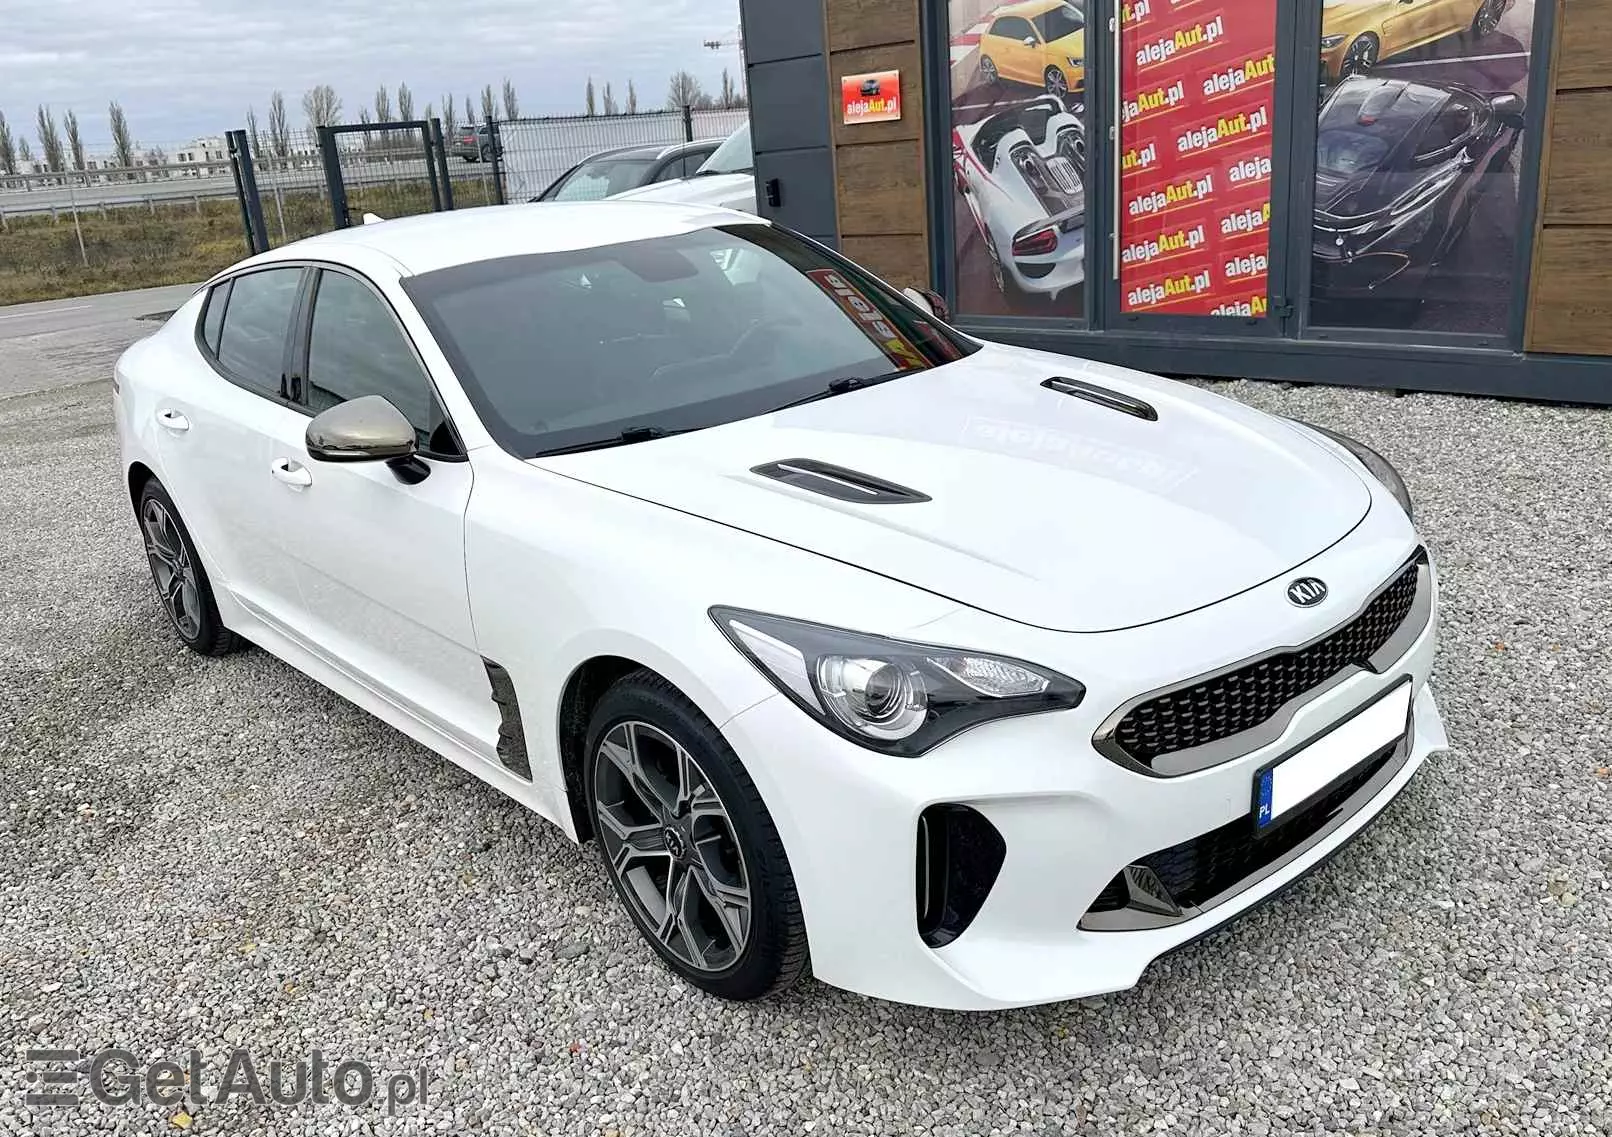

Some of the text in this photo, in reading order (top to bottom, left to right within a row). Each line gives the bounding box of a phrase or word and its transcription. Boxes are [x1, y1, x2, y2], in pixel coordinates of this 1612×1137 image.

[1136, 15, 1224, 65] alejaAut.pl
[847, 96, 897, 116] alejaAut.pl
[1122, 80, 1185, 122] jaAut.pl
[1177, 105, 1268, 152] alejaAut.pl
[1229, 156, 1272, 182] aleja
[1128, 174, 1213, 215] alejaAut.pl
[1122, 225, 1205, 263] alejaAut.pl
[1225, 253, 1267, 277] aleja
[1128, 270, 1211, 305] alejaAut.pl
[1290, 580, 1326, 603] KIA
[1259, 803, 1270, 819] PL
